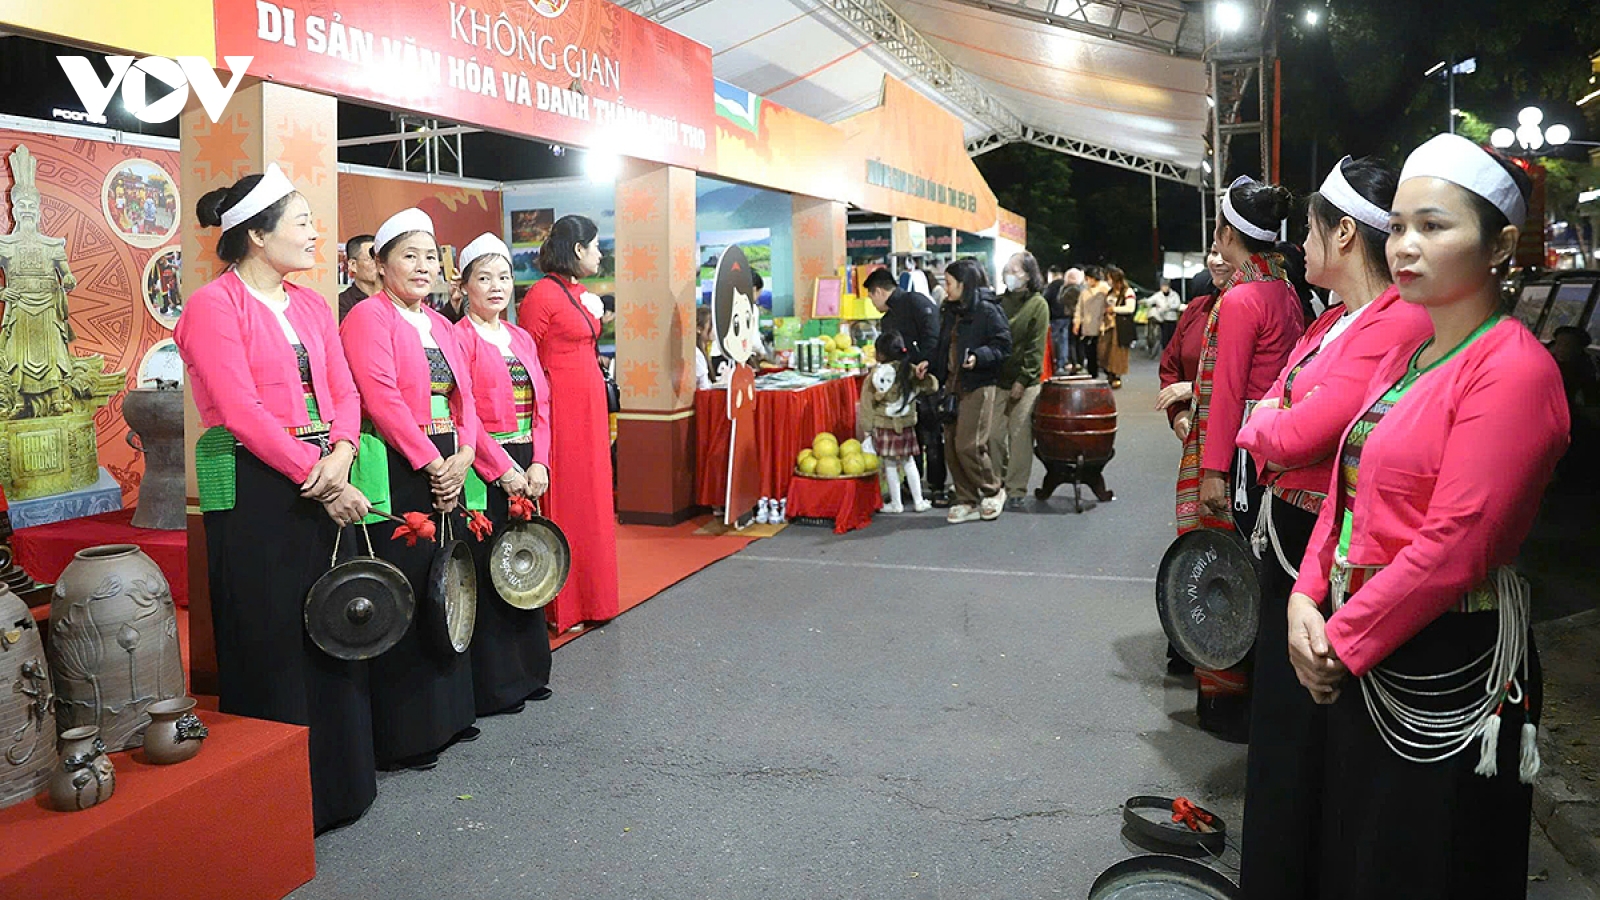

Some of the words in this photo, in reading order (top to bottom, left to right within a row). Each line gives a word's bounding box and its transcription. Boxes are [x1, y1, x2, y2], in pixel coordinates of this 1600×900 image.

[256, 0, 297, 47] DI
[305, 10, 375, 66] SẢN
[447, 55, 498, 98] HÓA
[502, 71, 533, 107] VÀ
[536, 81, 590, 121] DANH
[680, 122, 706, 155] THỌ
[449, 1, 557, 70] KHÔNG
[564, 43, 621, 92] GIAN
